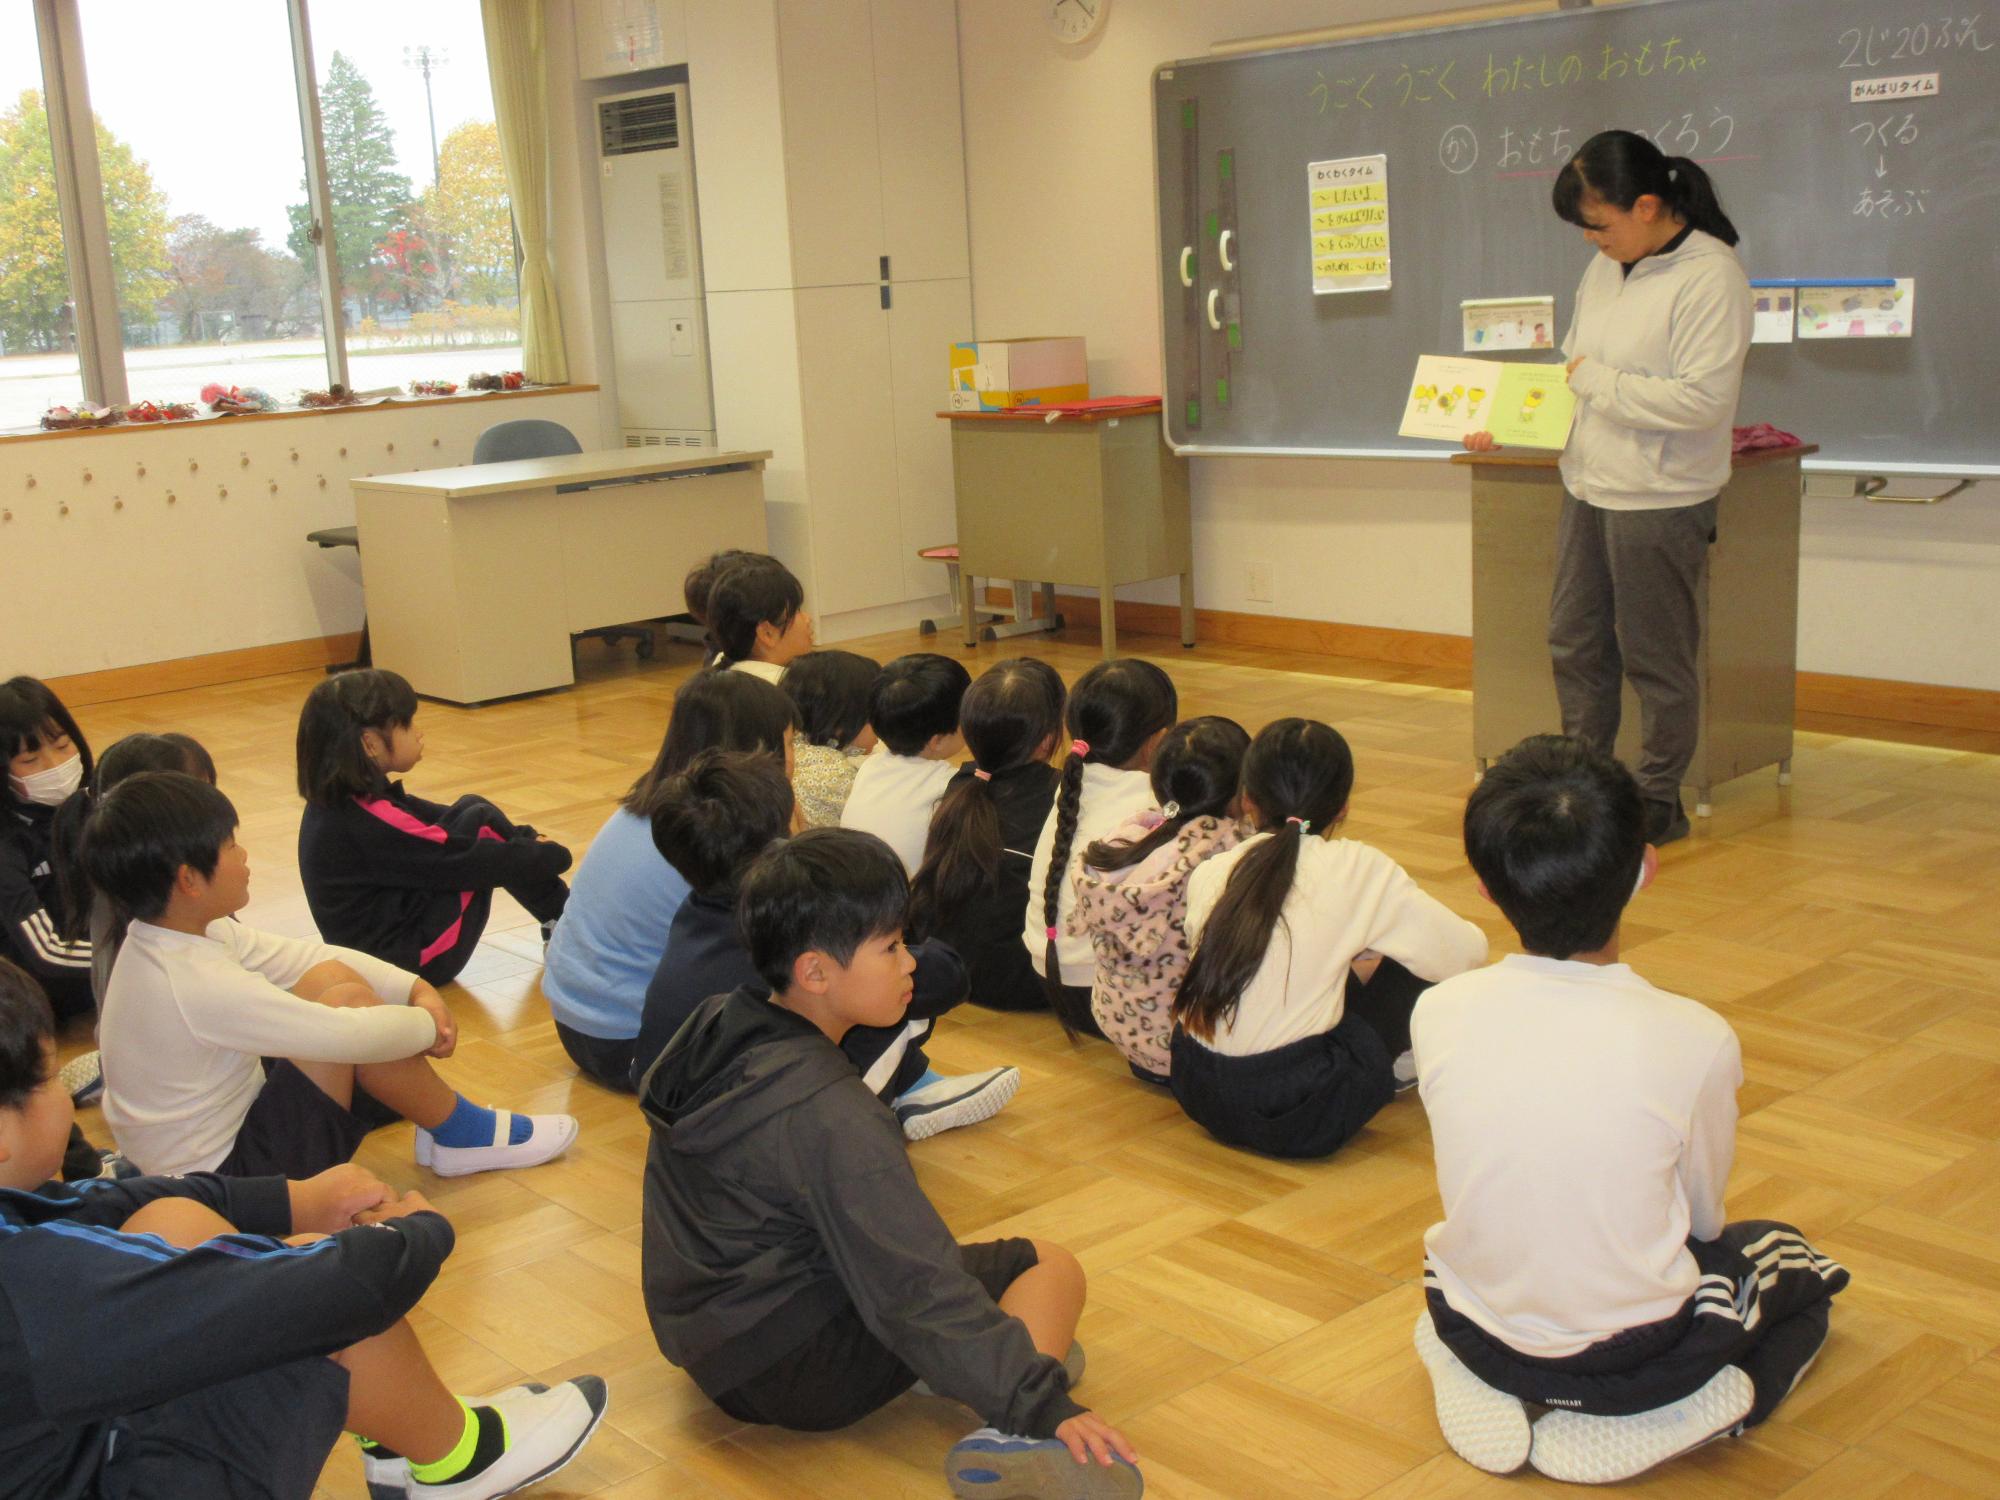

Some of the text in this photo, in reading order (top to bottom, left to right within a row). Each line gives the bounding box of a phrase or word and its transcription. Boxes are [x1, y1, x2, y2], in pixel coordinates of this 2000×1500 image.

[1310, 37, 1706, 114] うごく うごく わたしの おもちゃ
[1854, 79, 1935, 96] がんばりタイム
[1850, 113, 1918, 146] つくる
[1317, 166, 1374, 180] わくわくタイム
[1853, 188, 1930, 218] あそぶ
